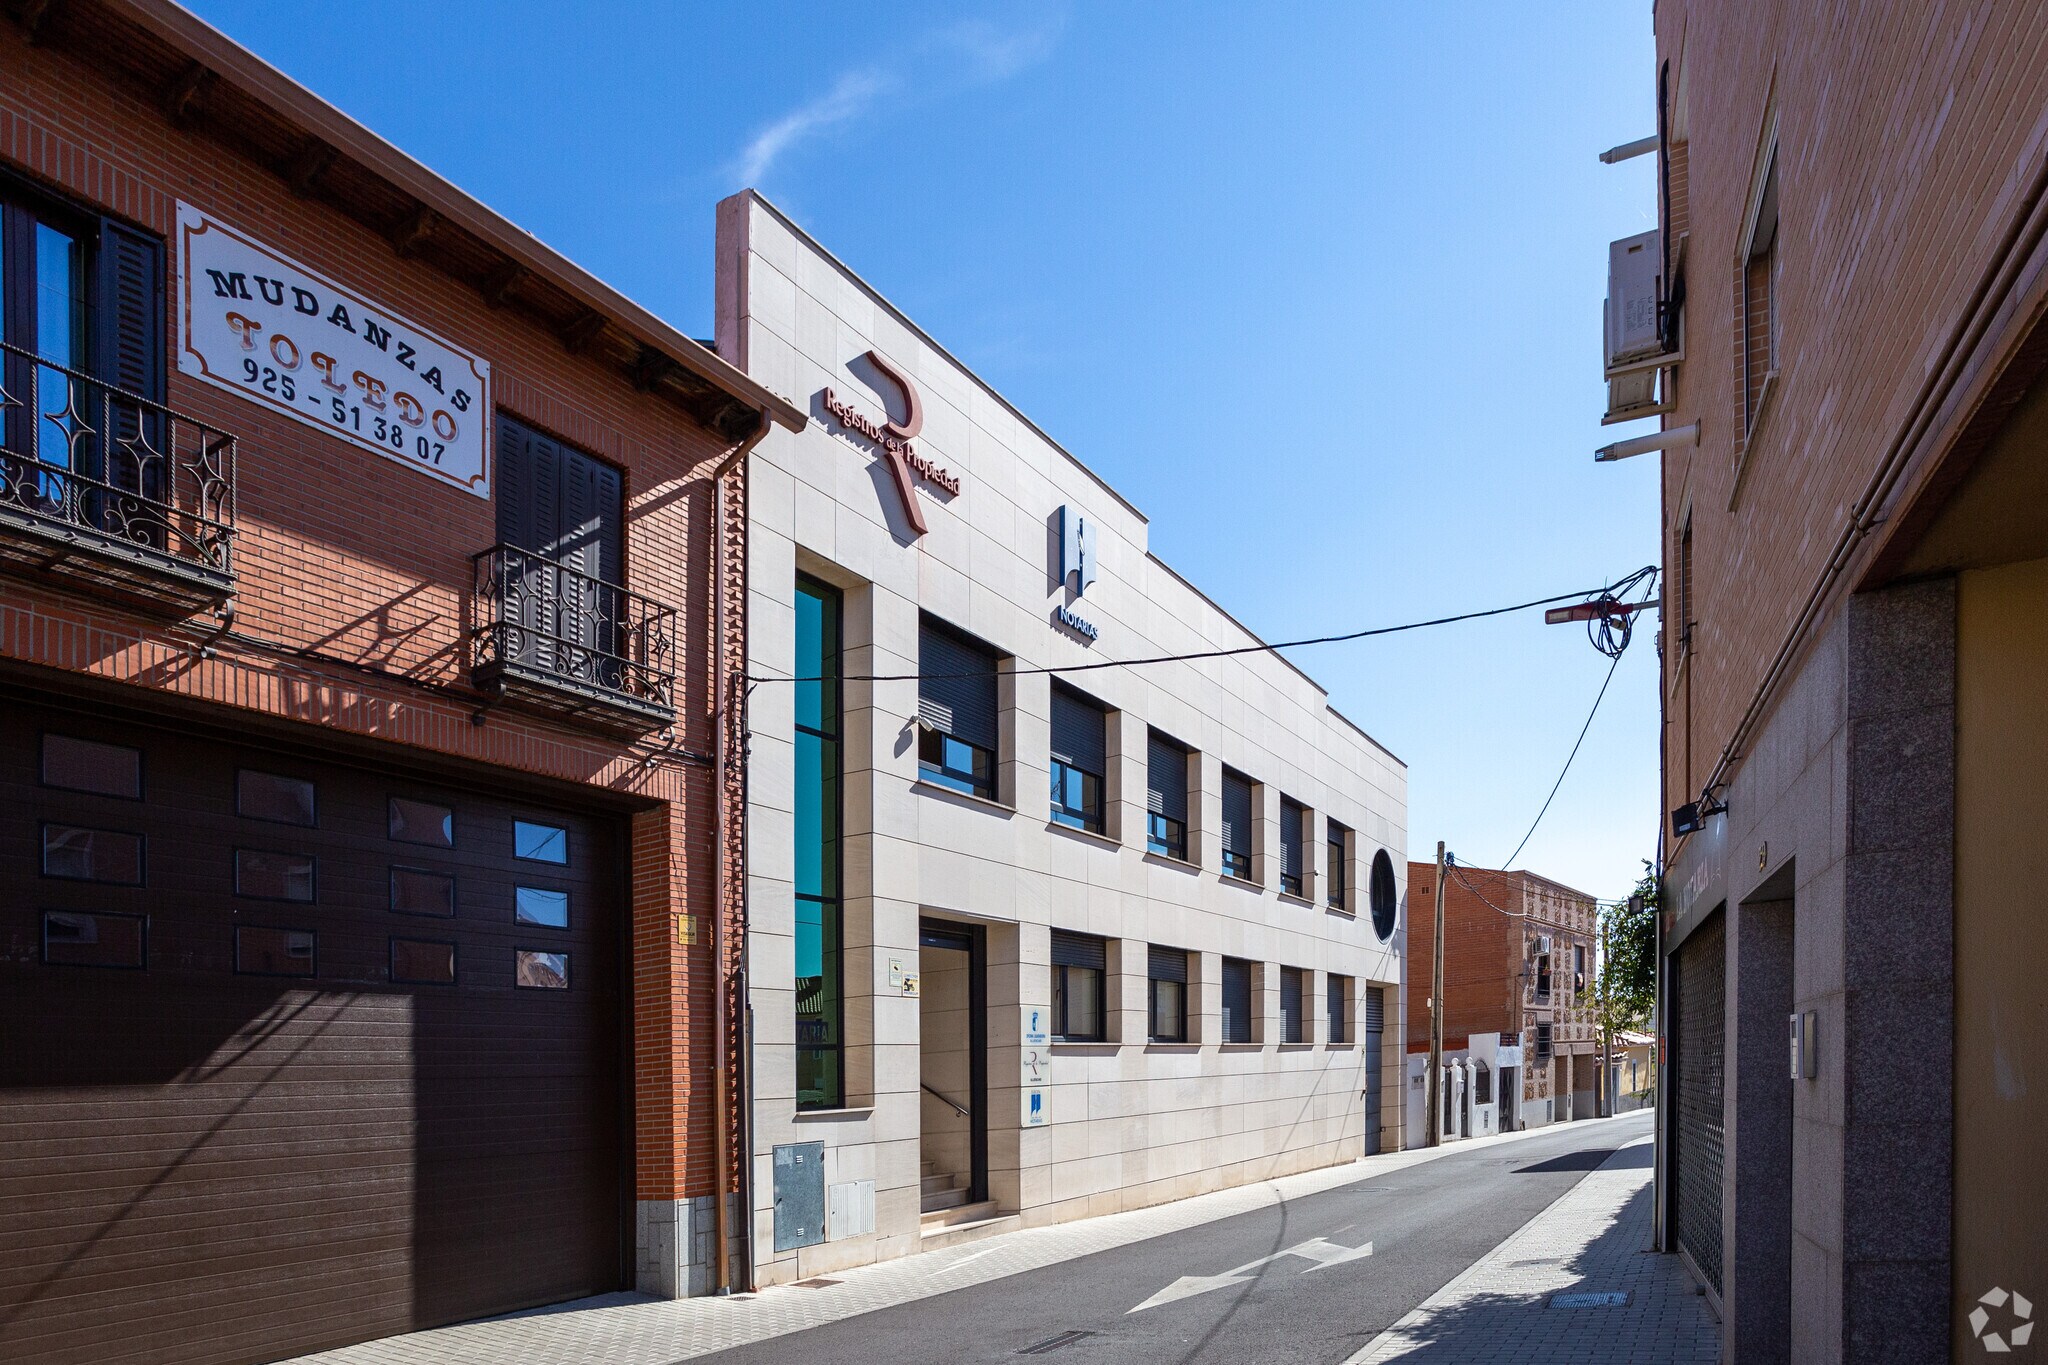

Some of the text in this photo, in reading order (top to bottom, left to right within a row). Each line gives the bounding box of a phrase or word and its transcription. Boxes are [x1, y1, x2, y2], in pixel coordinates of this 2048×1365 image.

[205, 268, 471, 412] MUDANZAS
[225, 311, 459, 442] TOLEDO
[243, 358, 296, 401] 925
[332, 396, 360, 431] 51
[374, 416, 403, 448] 38
[416, 436, 445, 465] 07
[825, 387, 884, 443] Registros
[906, 443, 960, 495] Propiedad
